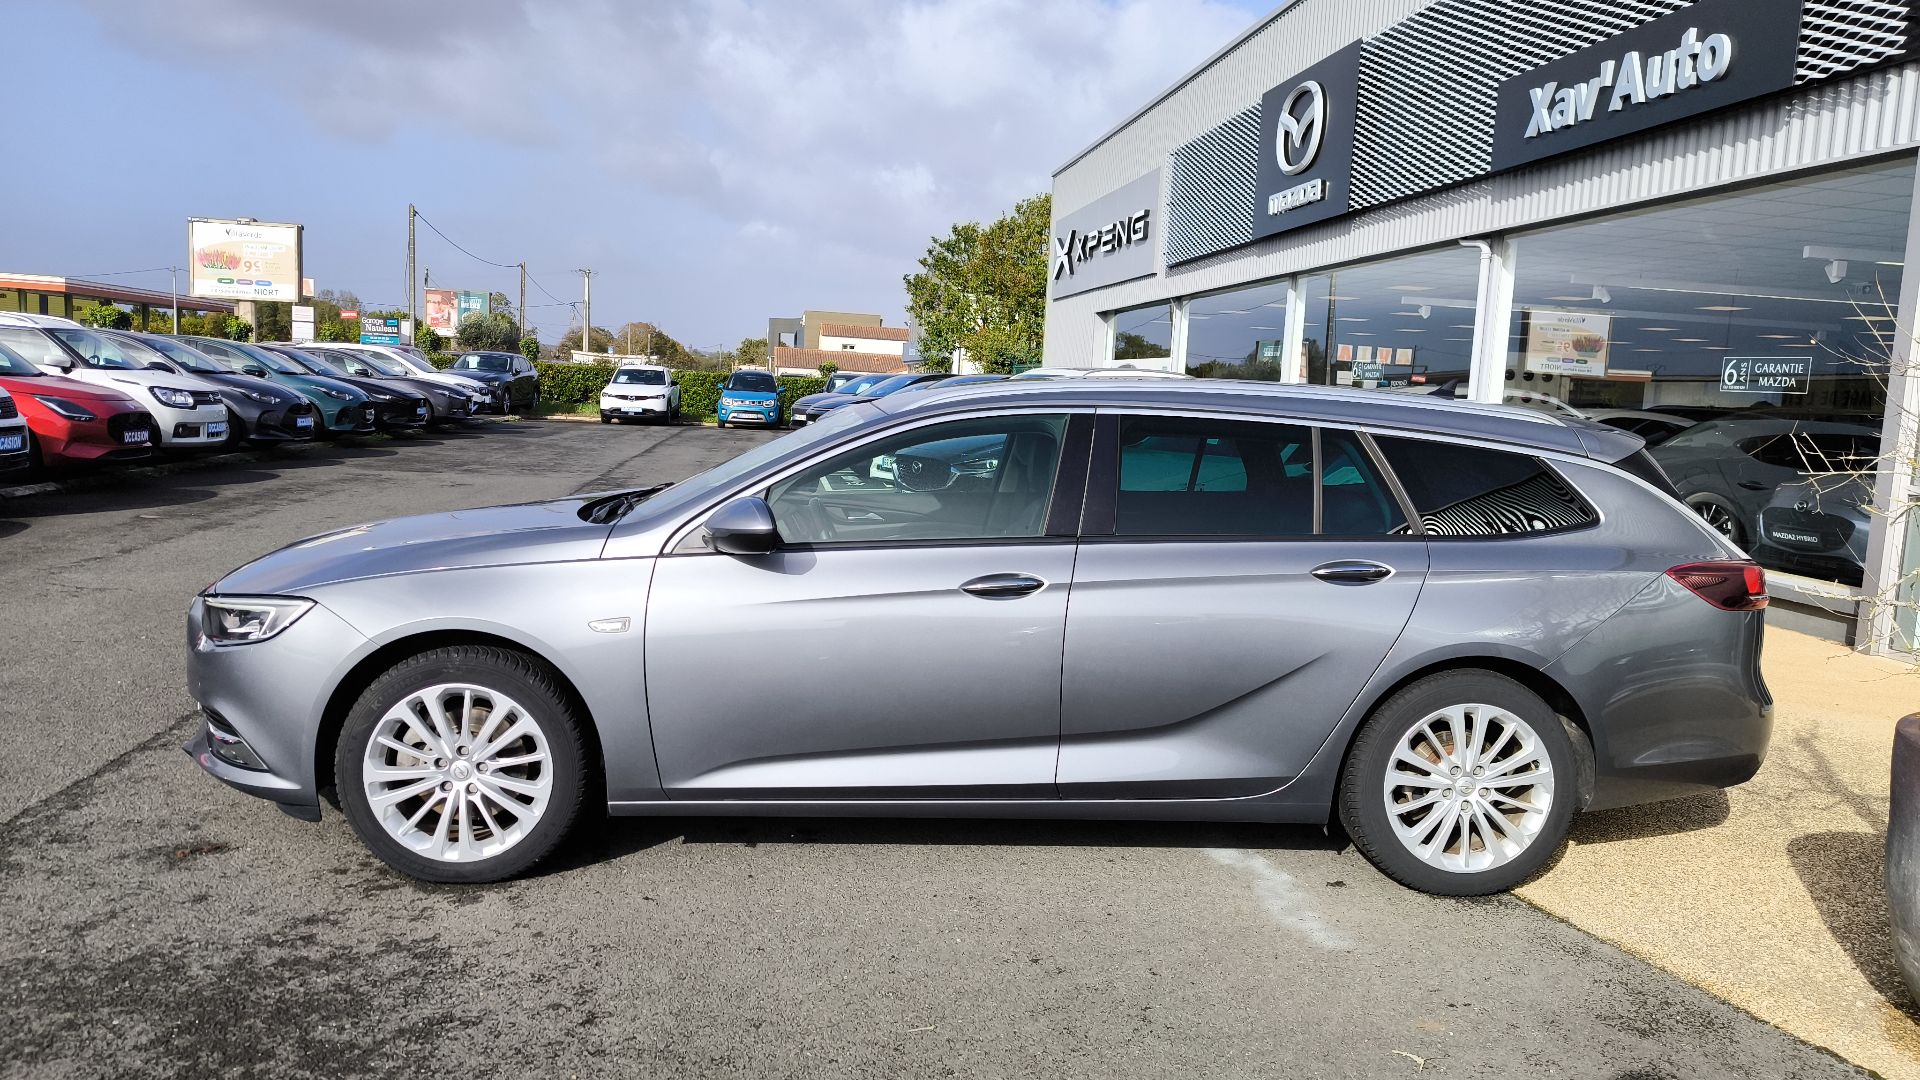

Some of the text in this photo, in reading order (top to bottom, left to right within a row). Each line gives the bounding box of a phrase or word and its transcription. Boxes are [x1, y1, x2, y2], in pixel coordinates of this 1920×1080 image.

[1524, 27, 1732, 138] Xav'Auto
[1268, 178, 1324, 216] mazda
[1075, 209, 1150, 262] XPENG
[361, 317, 384, 325] Garage
[365, 324, 398, 333] Nauleau
[1724, 359, 1737, 386] 6
[1739, 362, 1748, 383] ANS
[1754, 363, 1804, 374] GARANTIE
[1758, 376, 1797, 388] MAZDA
[124, 431, 149, 442] OCCASION
[1772, 531, 1818, 543] MAZDA2 HYBRID
